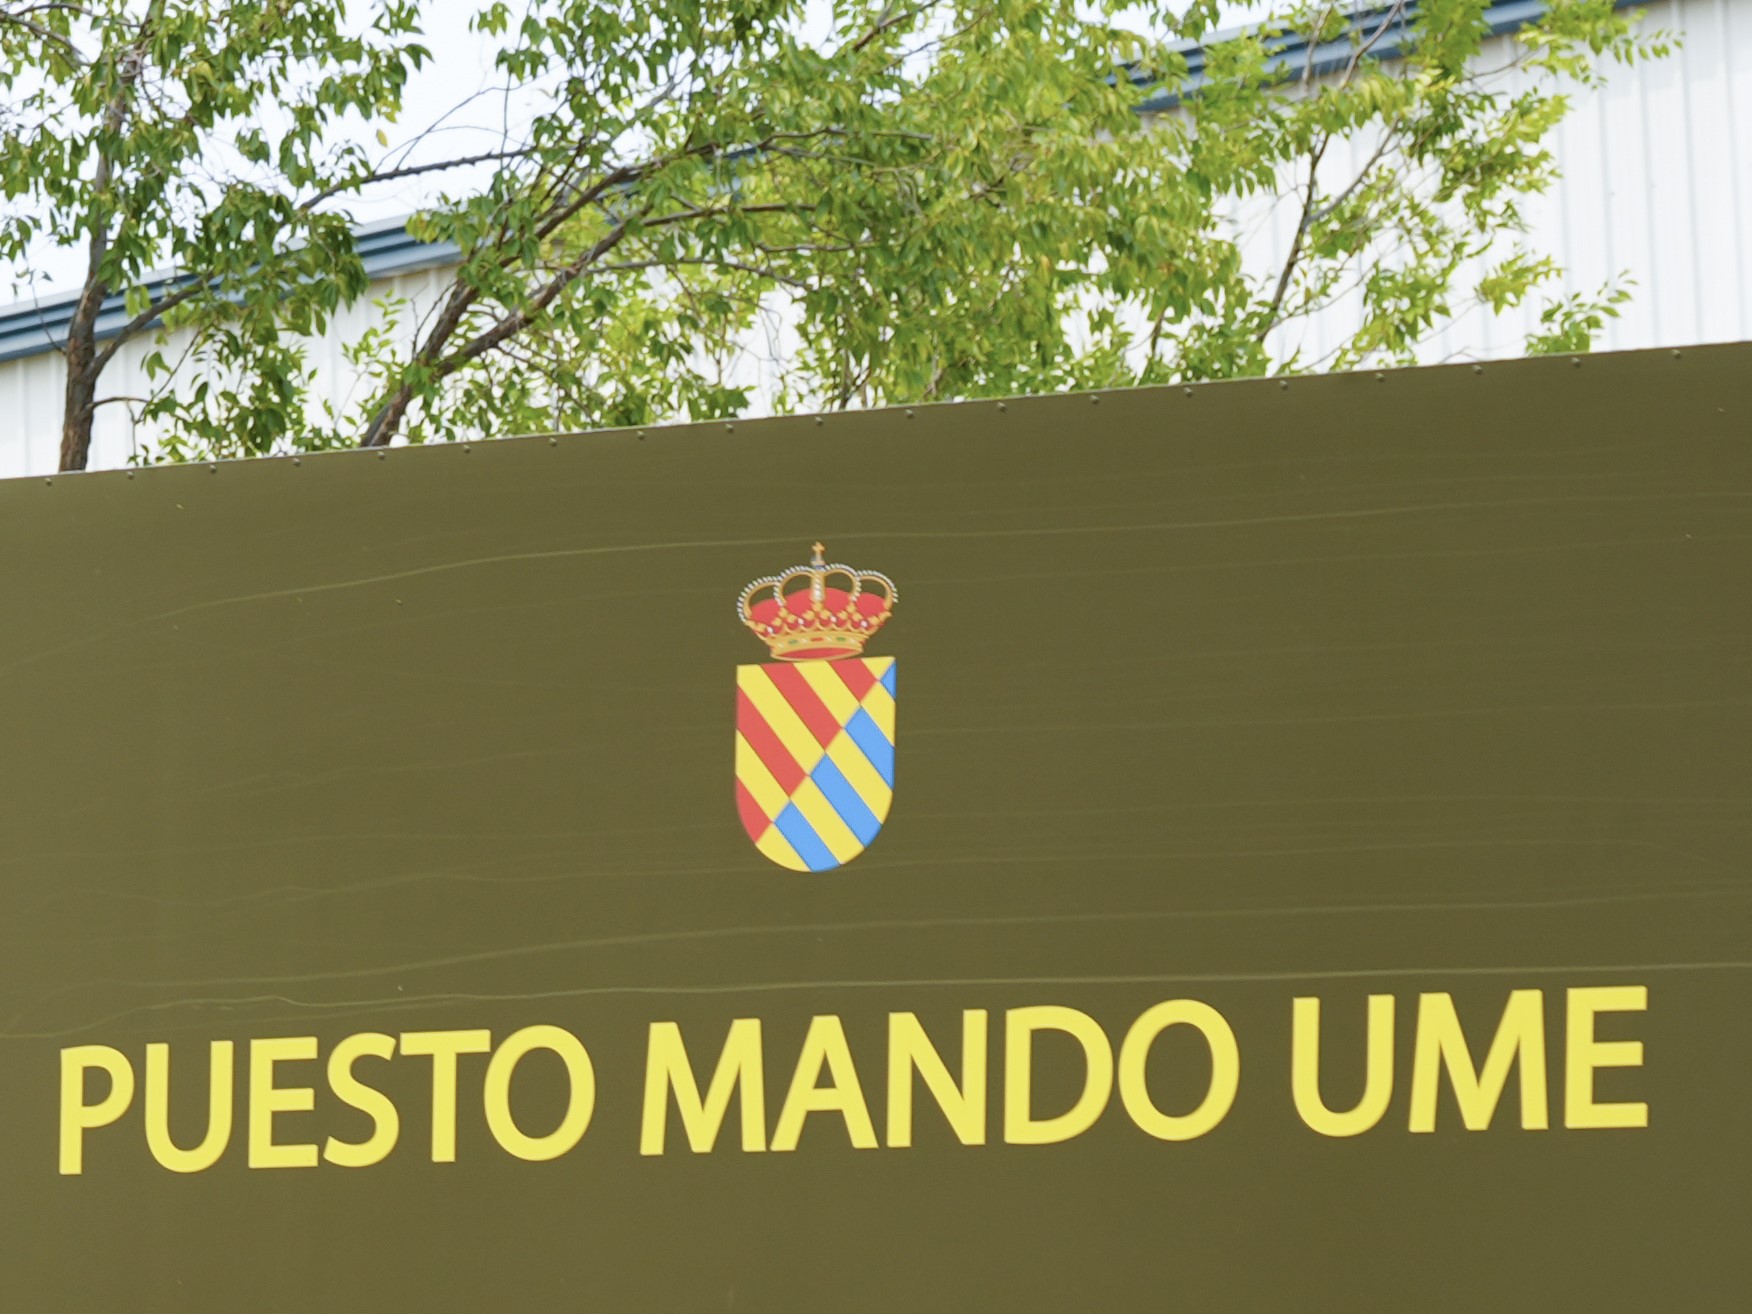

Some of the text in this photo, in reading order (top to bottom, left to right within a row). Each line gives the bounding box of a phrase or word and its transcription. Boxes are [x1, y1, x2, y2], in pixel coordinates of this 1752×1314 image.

[58, 985, 1649, 1175] PUESTO MANDO UME
